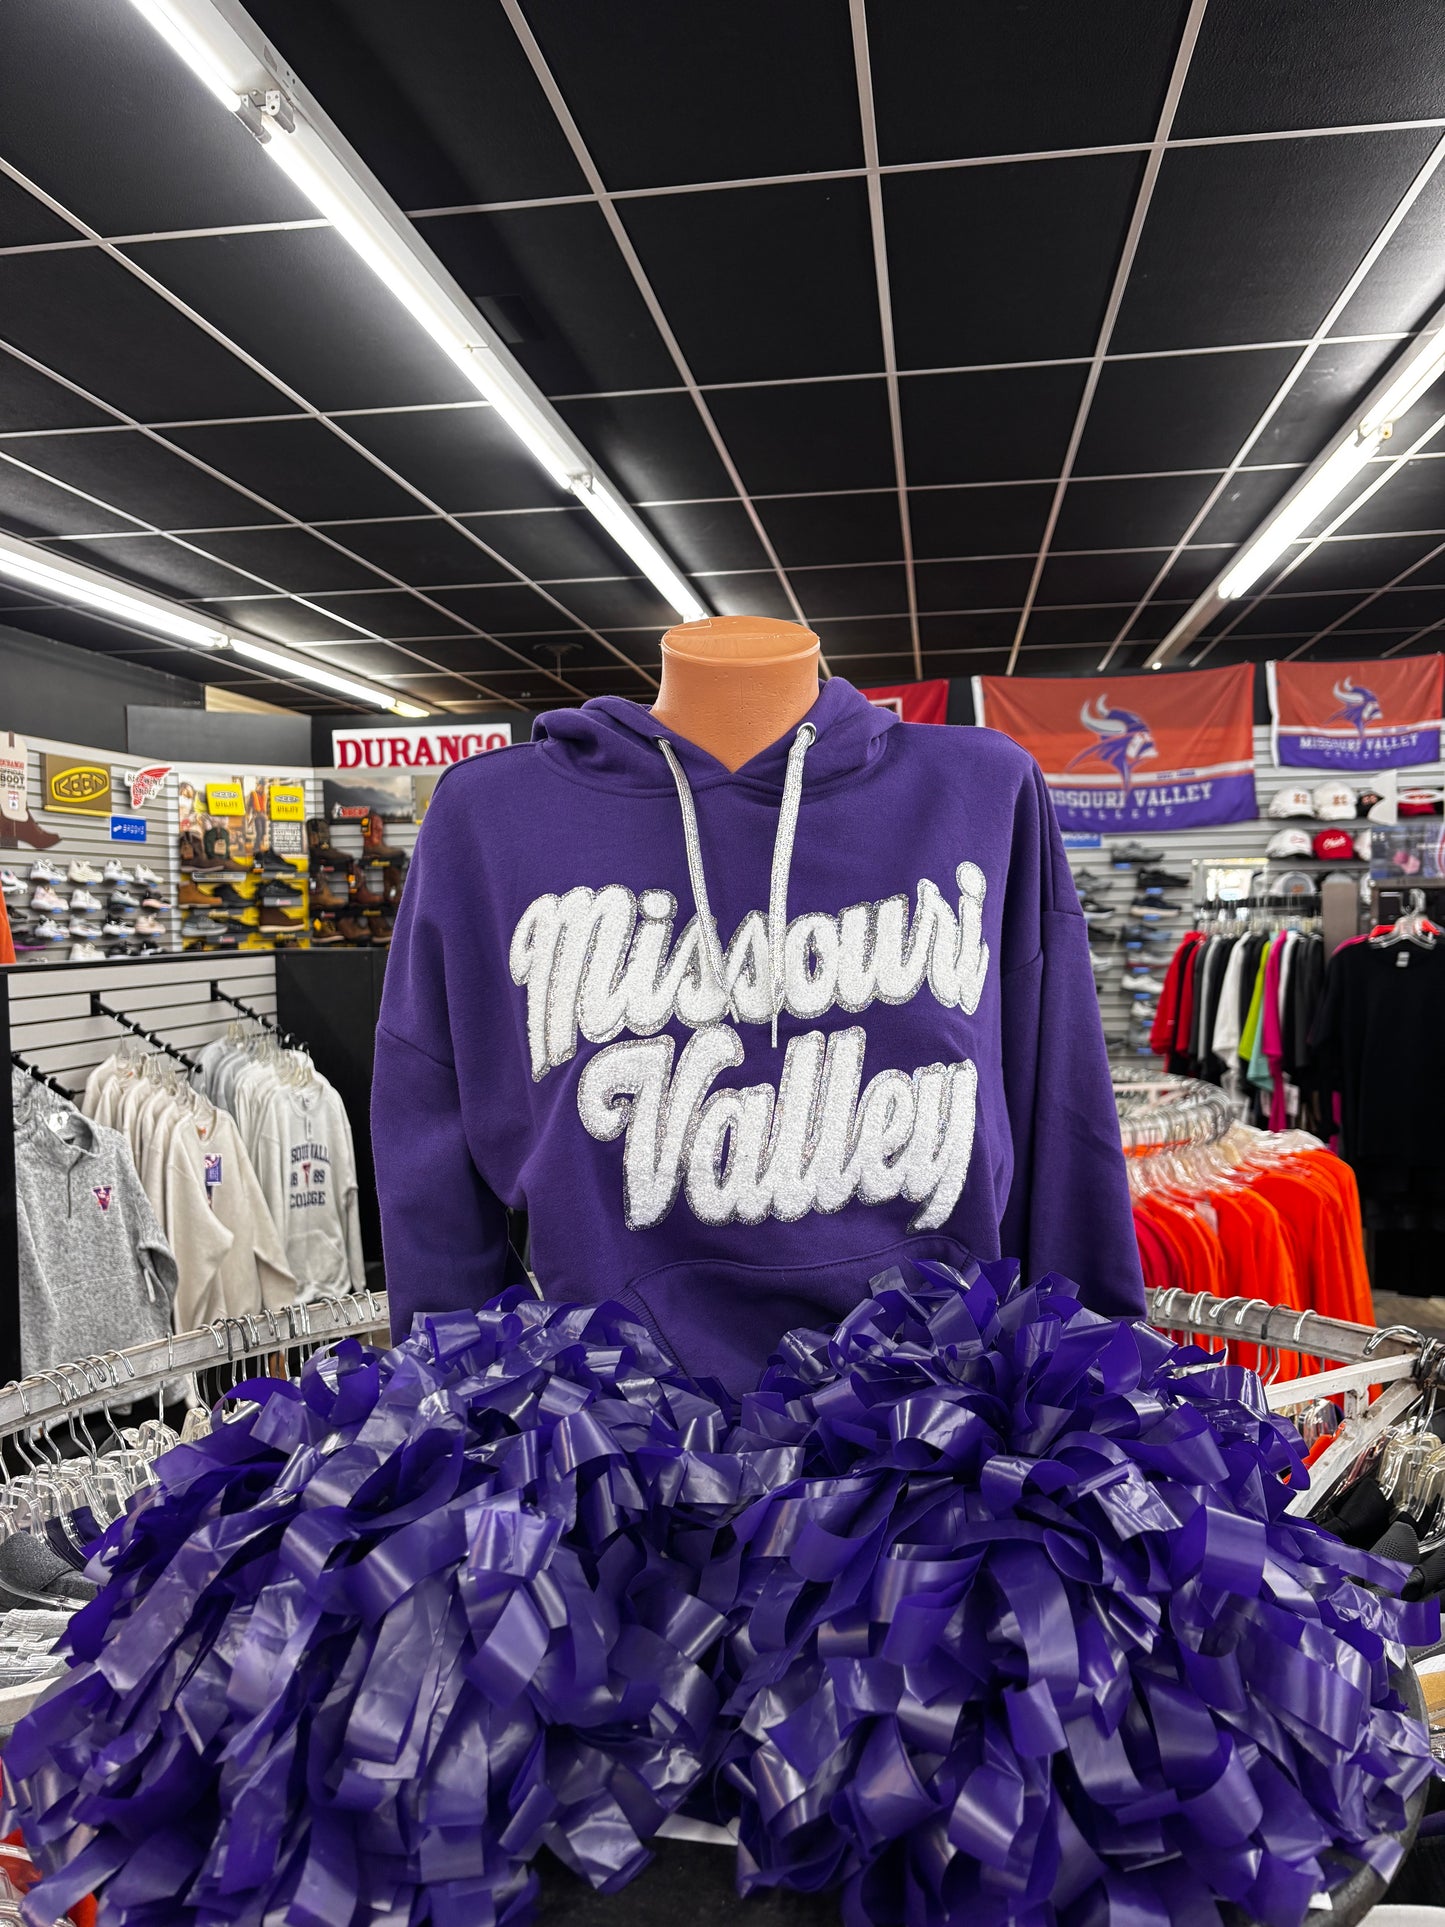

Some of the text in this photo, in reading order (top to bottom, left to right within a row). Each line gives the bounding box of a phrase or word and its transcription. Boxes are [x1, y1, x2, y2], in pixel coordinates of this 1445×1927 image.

[1366, 733, 1419, 750] VALLEY
[56, 773, 105, 796] KEEN
[1134, 782, 1213, 807] VALLEY
[509, 861, 989, 1082] Missouri
[577, 1023, 977, 1234] Valley
